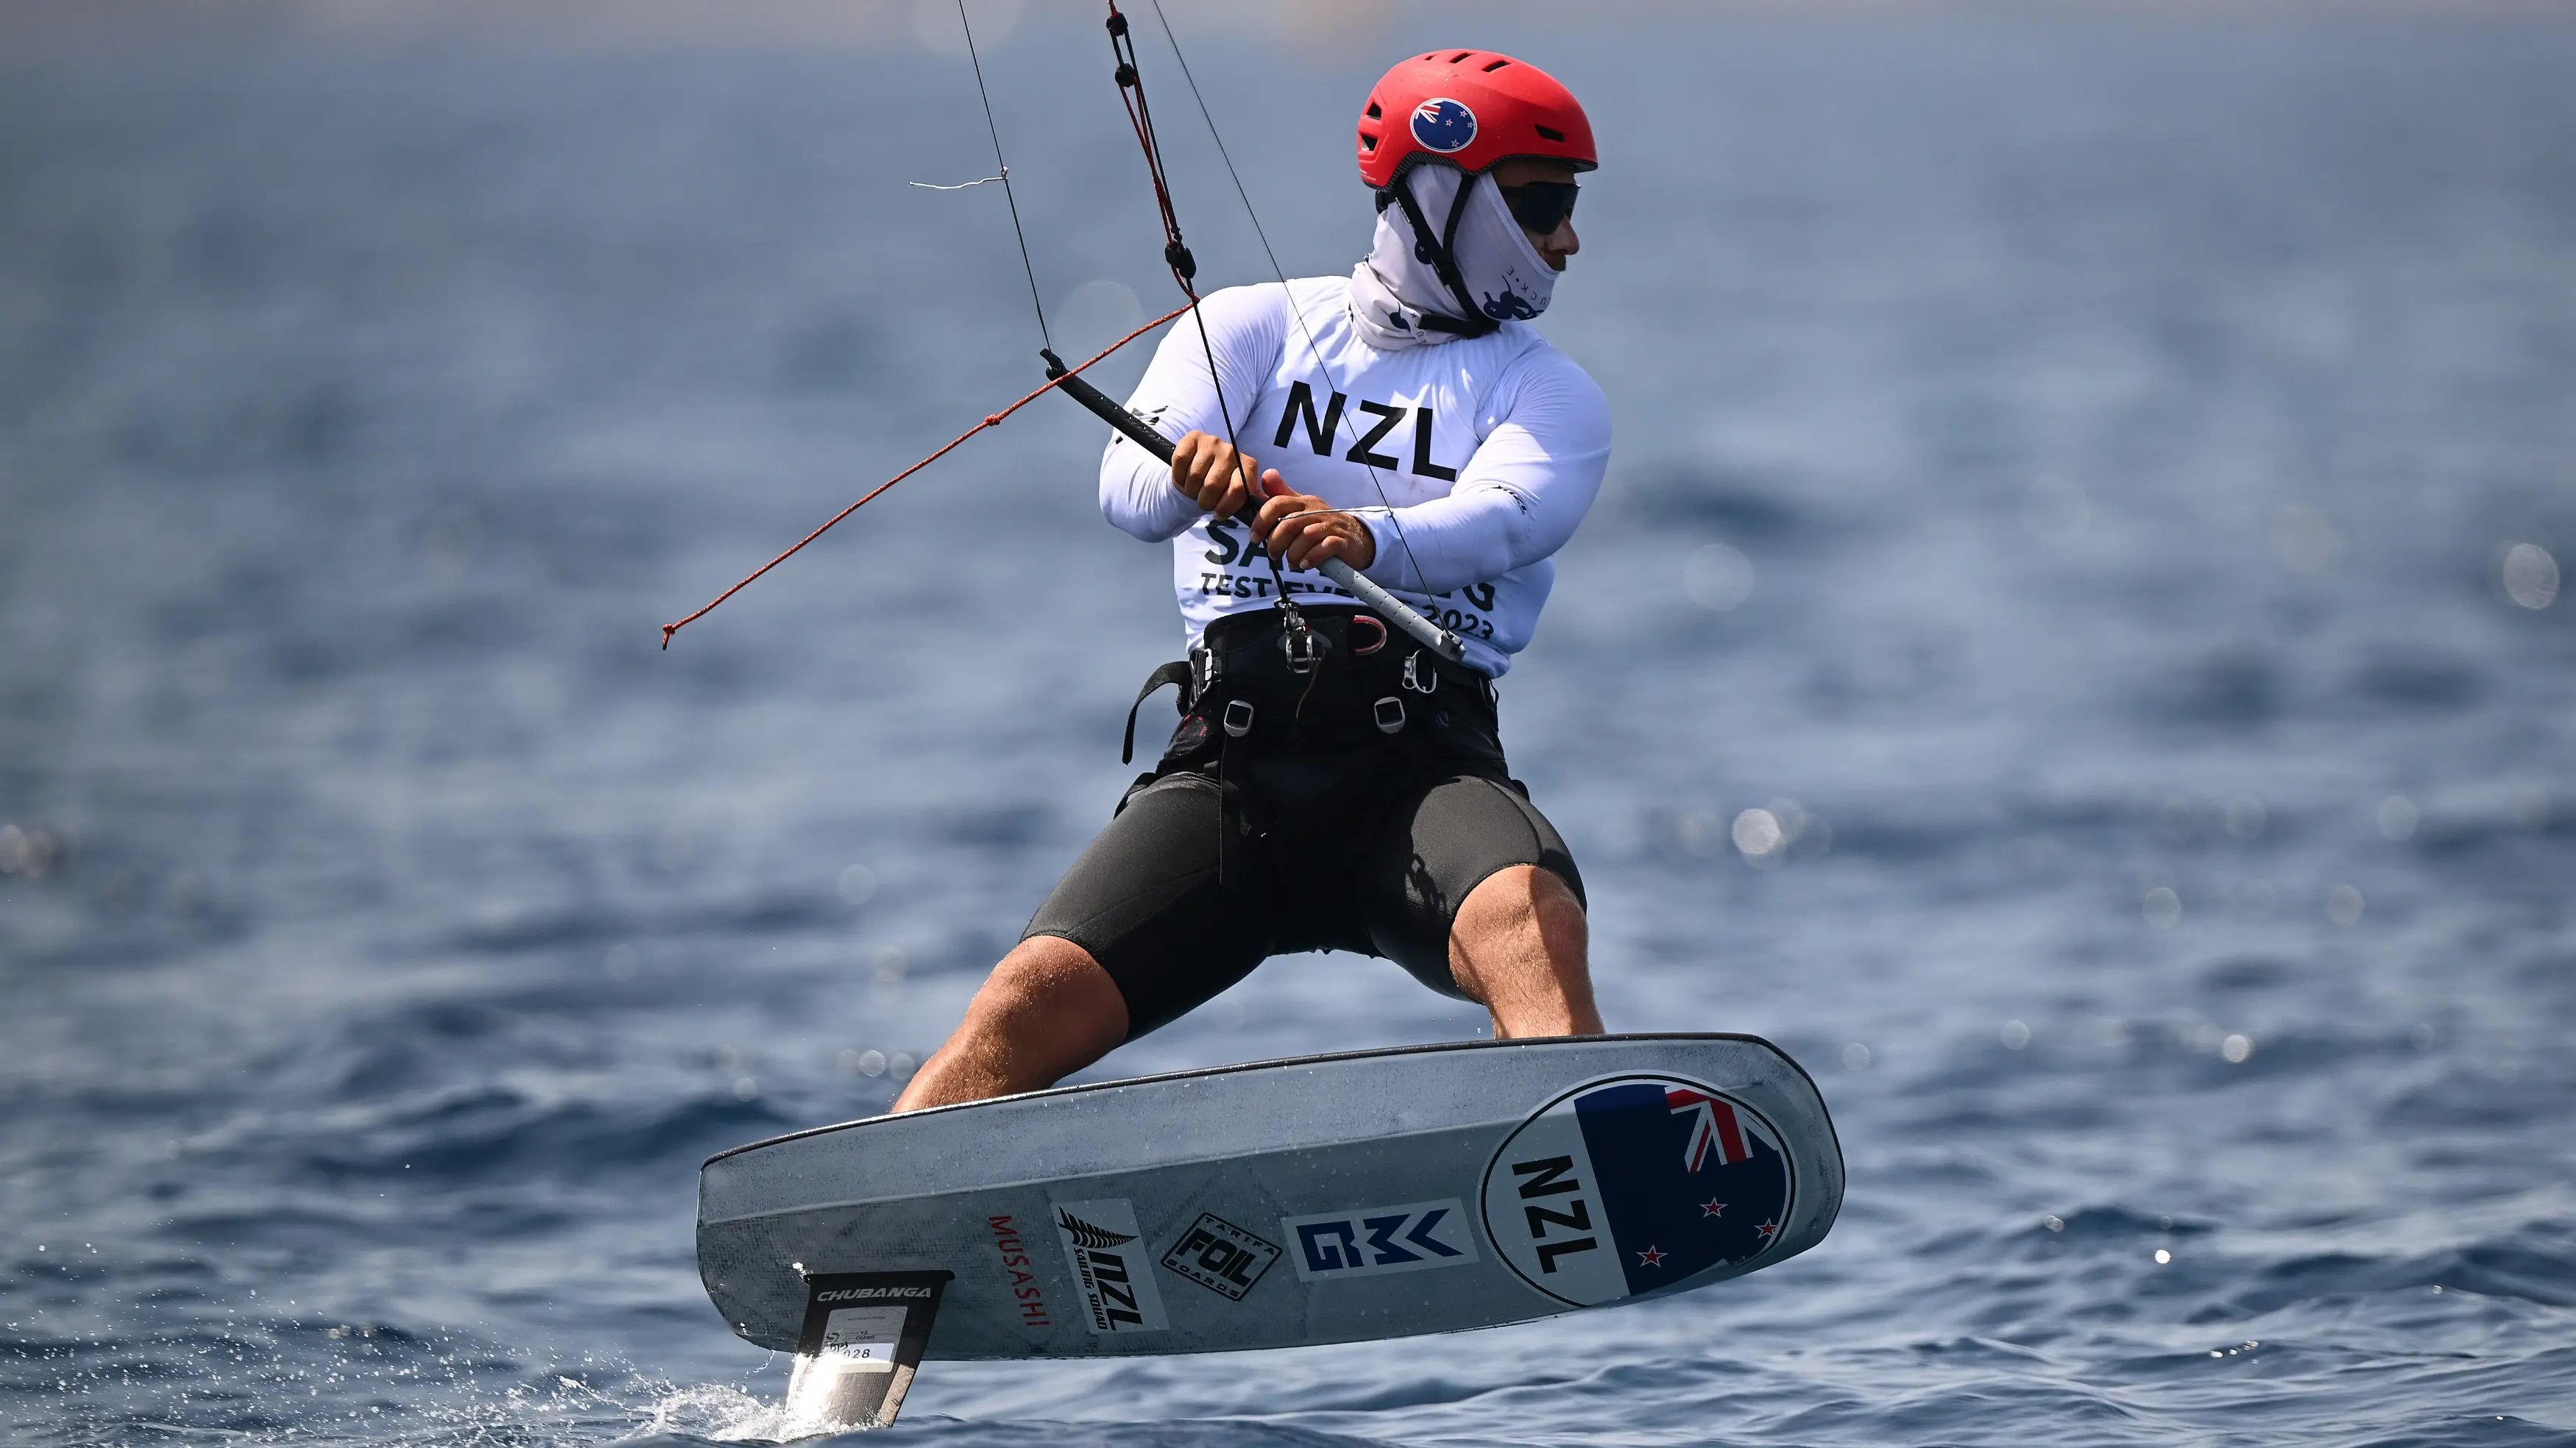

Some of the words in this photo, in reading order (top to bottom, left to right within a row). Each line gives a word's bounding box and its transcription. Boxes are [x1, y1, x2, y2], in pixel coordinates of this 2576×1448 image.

[1273, 380, 1457, 482] NZL
[1201, 572, 1272, 597] TEST
[1423, 605, 1494, 639] 2023
[1206, 1216, 1274, 1255] TARIFA
[1512, 1154, 1598, 1274] NZL
[988, 1215, 1050, 1326] MUSASHI
[1167, 1258, 1239, 1297] BOARDS
[1175, 1227, 1256, 1287] FOIL
[817, 1288, 931, 1302] CHUBANGA
[1074, 1247, 1094, 1289] SAILING
[1087, 1293, 1108, 1330] SQUAD
[1087, 1250, 1144, 1331] NZL
